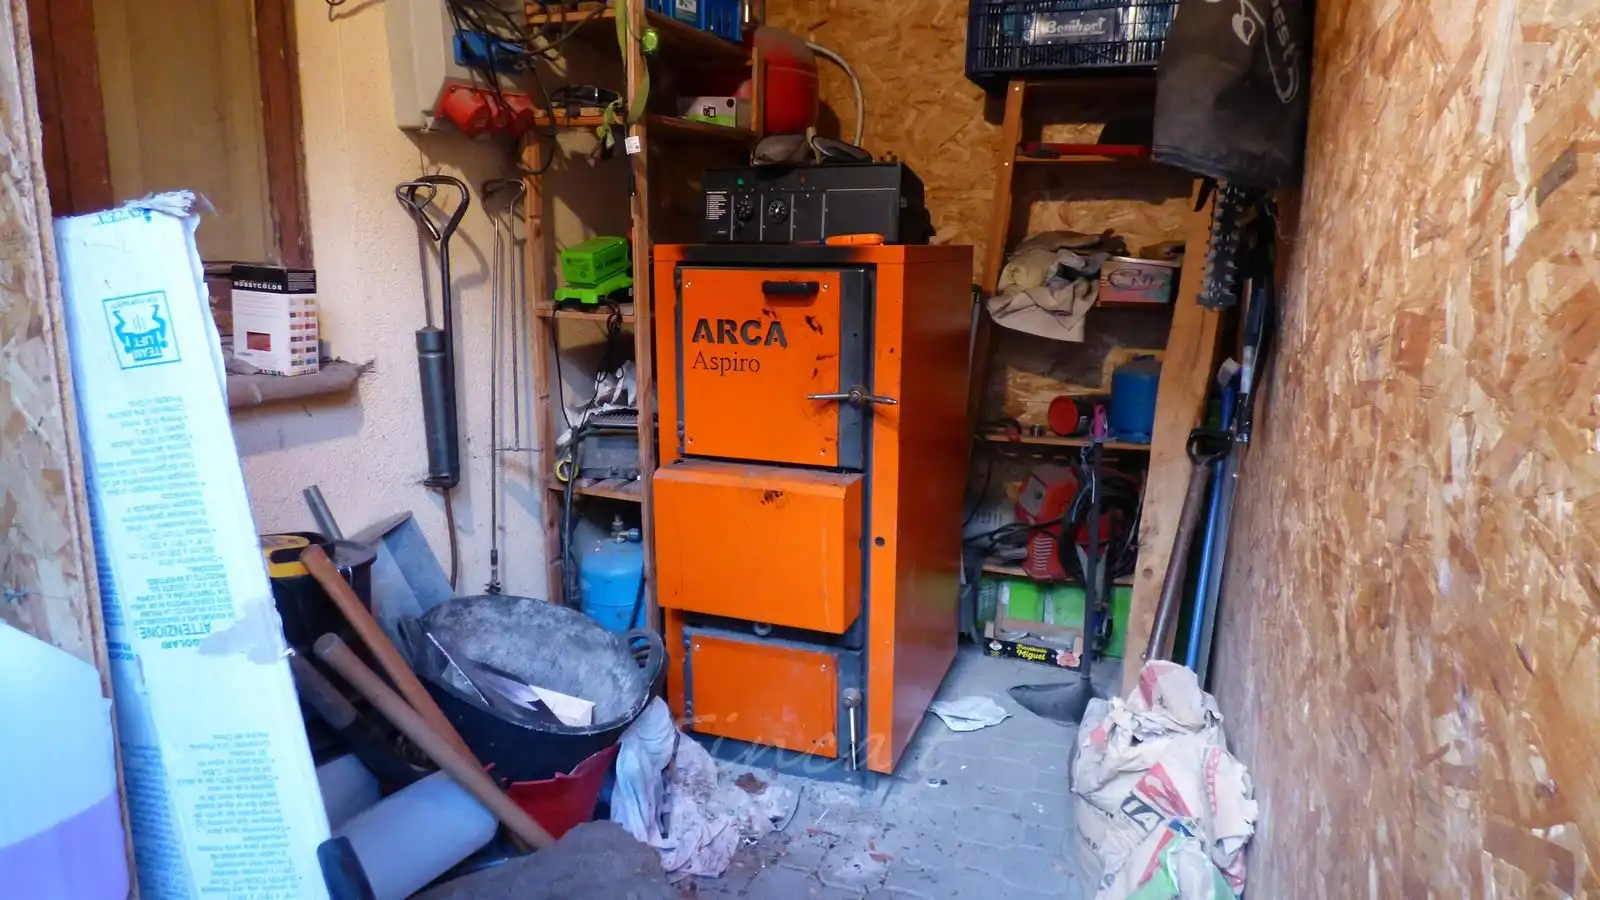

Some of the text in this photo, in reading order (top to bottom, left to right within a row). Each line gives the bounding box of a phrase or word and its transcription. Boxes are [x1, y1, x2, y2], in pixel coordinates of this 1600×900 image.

[132, 335, 154, 346] LIFT
[692, 319, 788, 348] ARCA
[692, 350, 760, 376] Aspiro
[1015, 649, 1046, 661] Miguel
